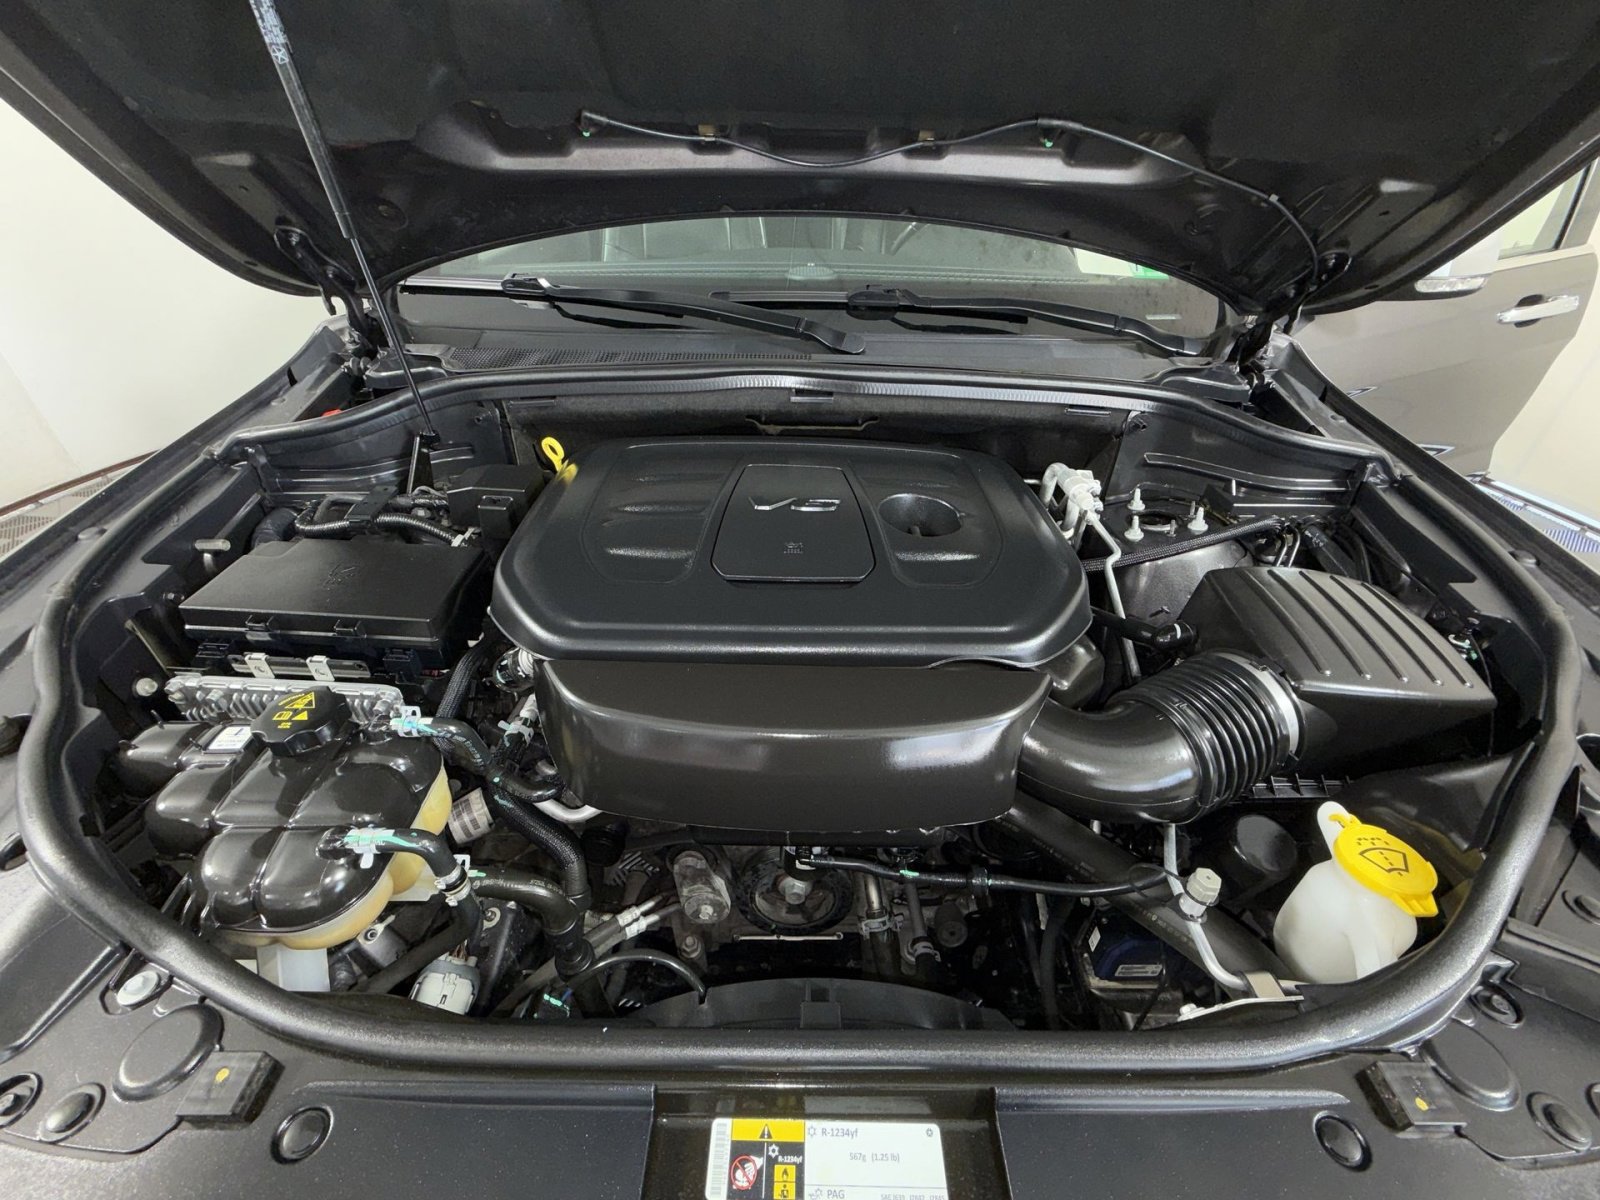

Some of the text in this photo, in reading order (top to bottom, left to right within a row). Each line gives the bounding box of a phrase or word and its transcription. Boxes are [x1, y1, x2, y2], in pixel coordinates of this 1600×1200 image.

[821, 1127, 858, 1140] R-1234yf
[849, 1152, 900, 1163] 567g (1.25 lb)
[827, 1189, 845, 1199] PAG
